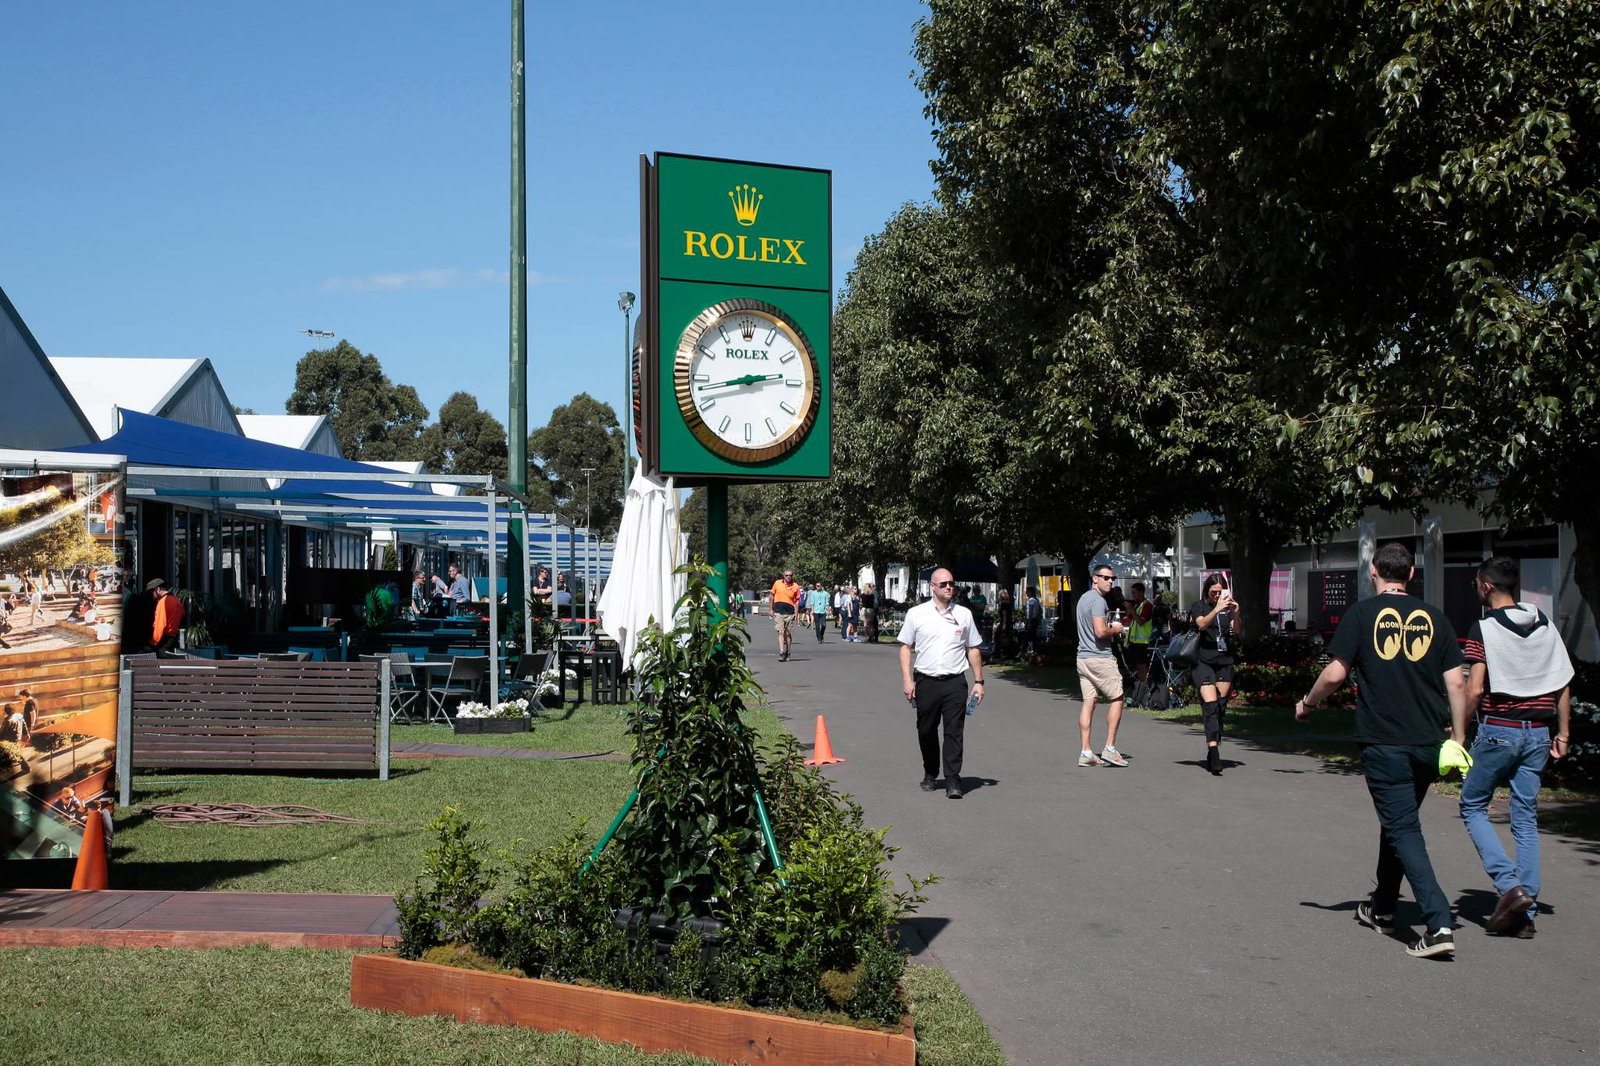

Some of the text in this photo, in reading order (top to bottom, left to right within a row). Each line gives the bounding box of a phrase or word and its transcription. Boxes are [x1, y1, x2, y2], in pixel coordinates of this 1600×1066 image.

[684, 231, 807, 265] ROLEX
[726, 348, 769, 360] ROLEX
[1379, 621, 1400, 629] MOON
